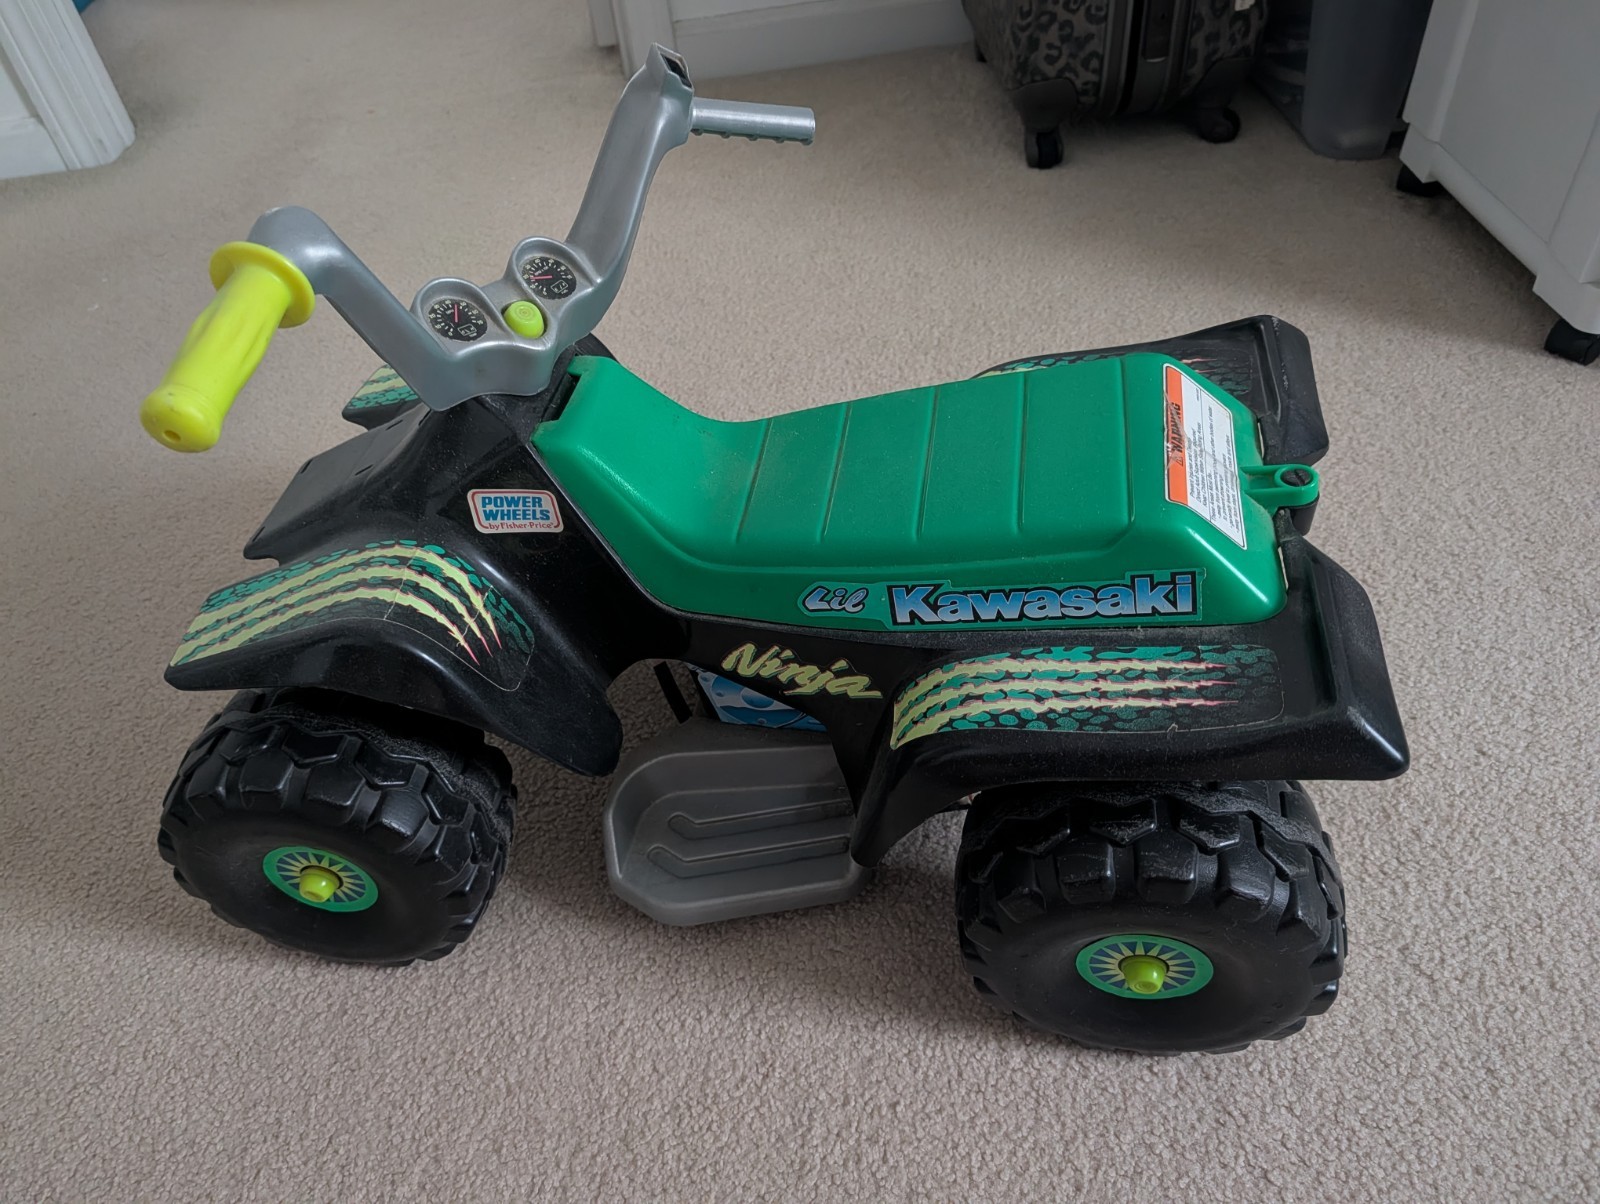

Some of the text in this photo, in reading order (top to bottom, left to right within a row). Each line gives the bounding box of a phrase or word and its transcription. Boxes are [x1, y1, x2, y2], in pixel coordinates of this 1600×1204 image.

[481, 496, 543, 508] POWER
[483, 509, 550, 521] WHEELS
[803, 574, 1195, 625] Lil Kawasaki
[721, 643, 883, 699] Ninja
